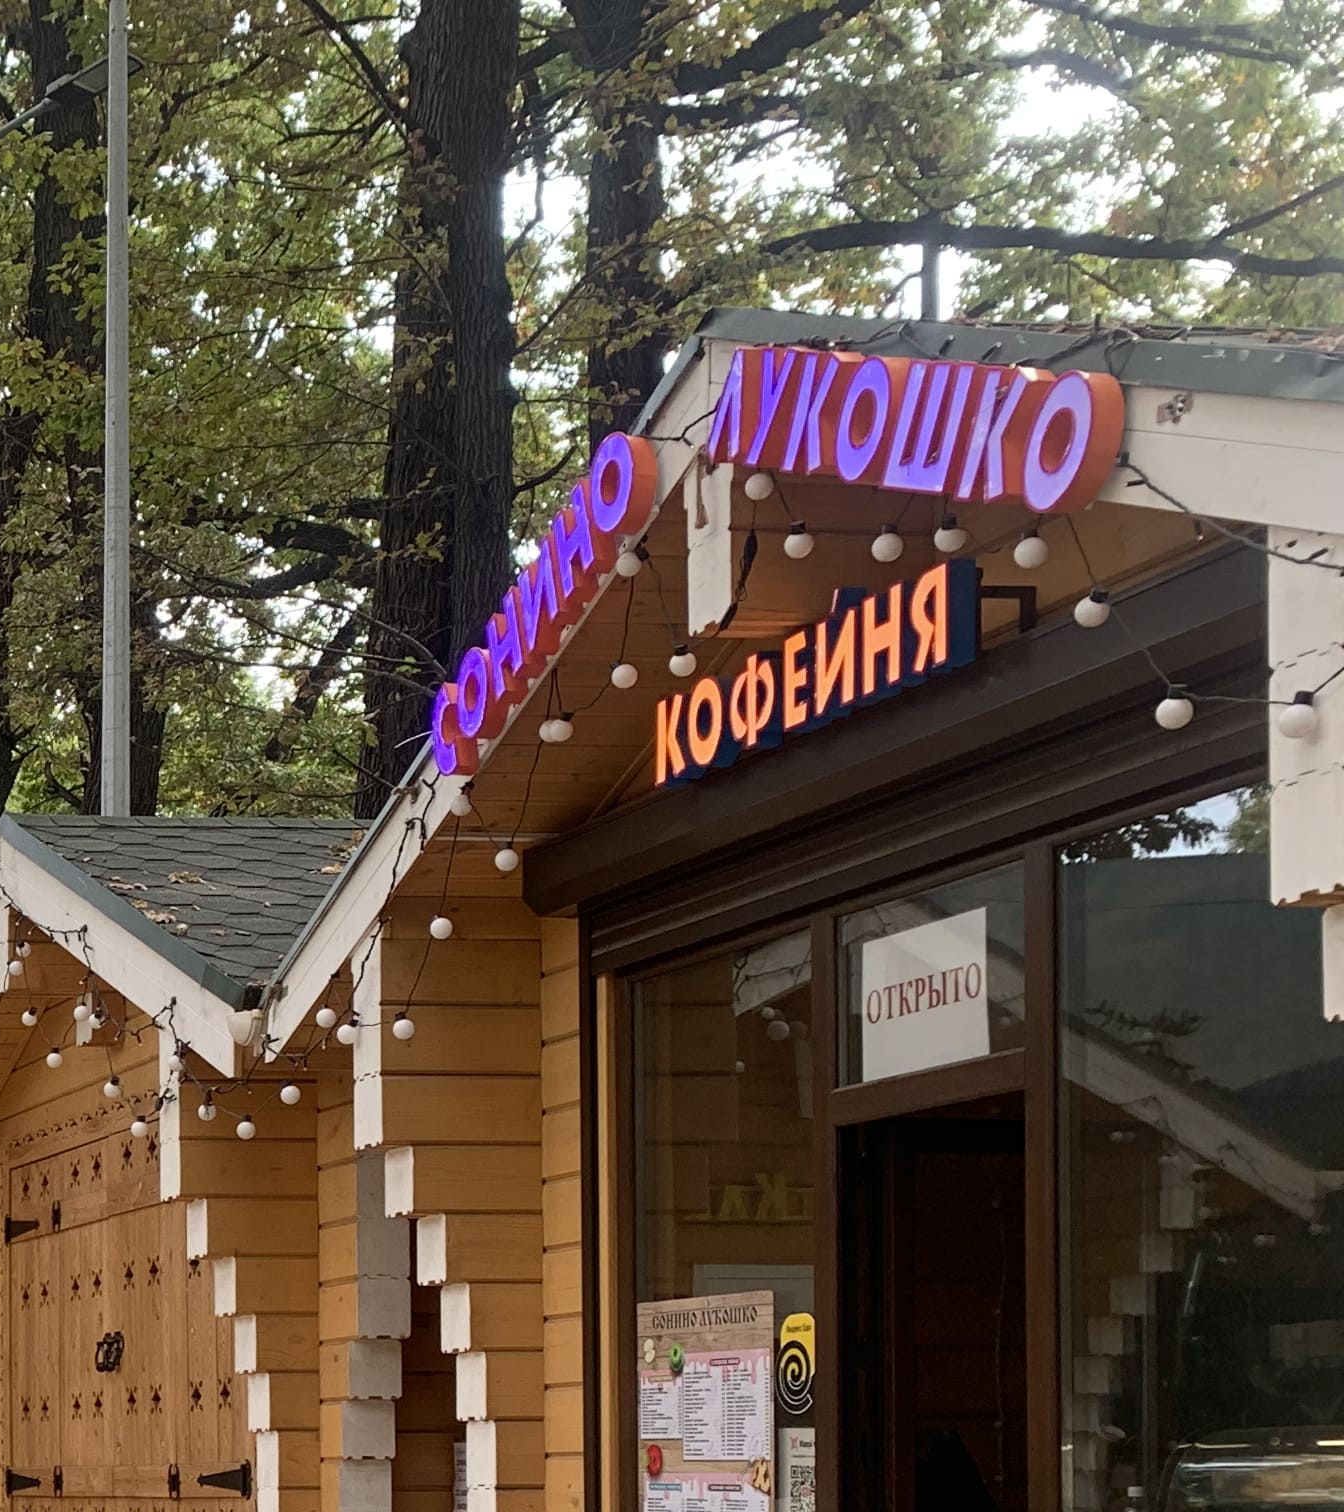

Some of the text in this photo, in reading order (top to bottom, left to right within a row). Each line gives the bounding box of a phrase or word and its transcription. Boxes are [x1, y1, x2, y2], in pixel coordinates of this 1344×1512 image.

[432, 347, 1096, 775] СОНИНО ЛУКОШКО
[654, 562, 949, 788] КОФЕЙНЯ
[866, 962, 982, 1024] ОТКРЫТО
